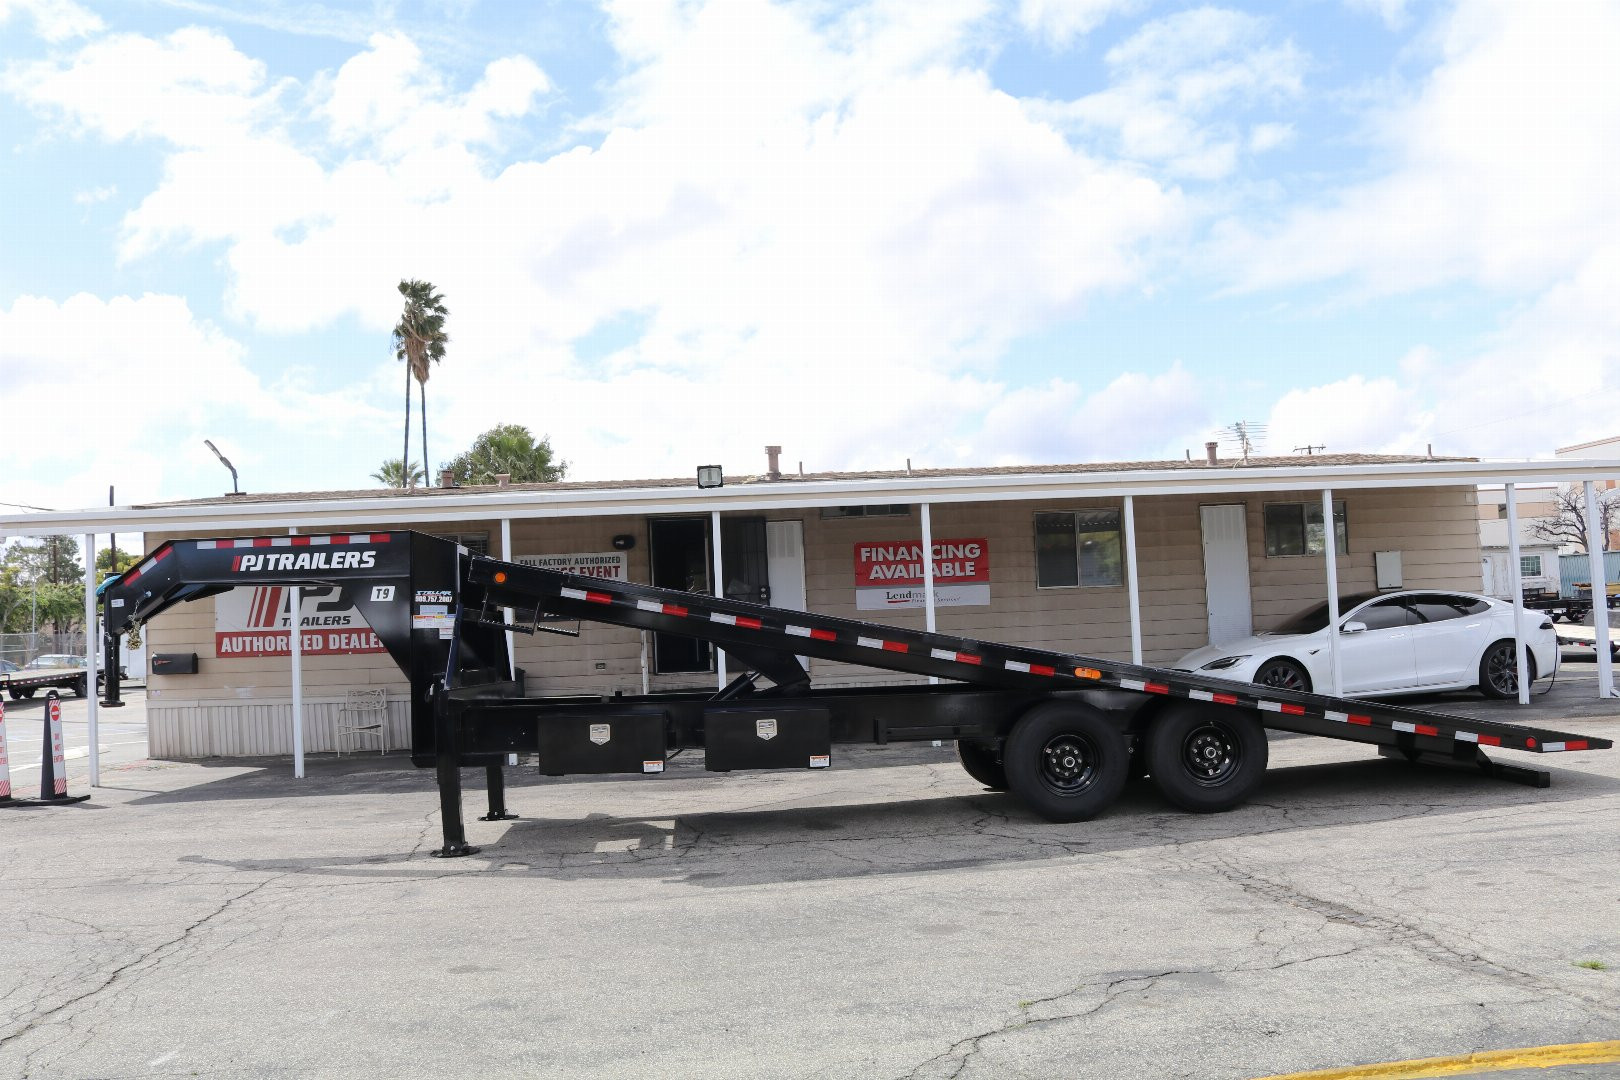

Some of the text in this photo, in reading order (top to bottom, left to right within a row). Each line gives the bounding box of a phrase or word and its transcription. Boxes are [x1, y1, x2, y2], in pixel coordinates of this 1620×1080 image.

[860, 544, 980, 562] FINANCING
[539, 558, 572, 566] FACTORY
[575, 556, 620, 564] AUTHORIZED
[870, 562, 976, 580] AVAILABLE
[376, 588, 390, 599] T9
[886, 590, 939, 600] Lendmak
[282, 616, 351, 626] TAILERS
[221, 635, 322, 652] AUTHORIED
